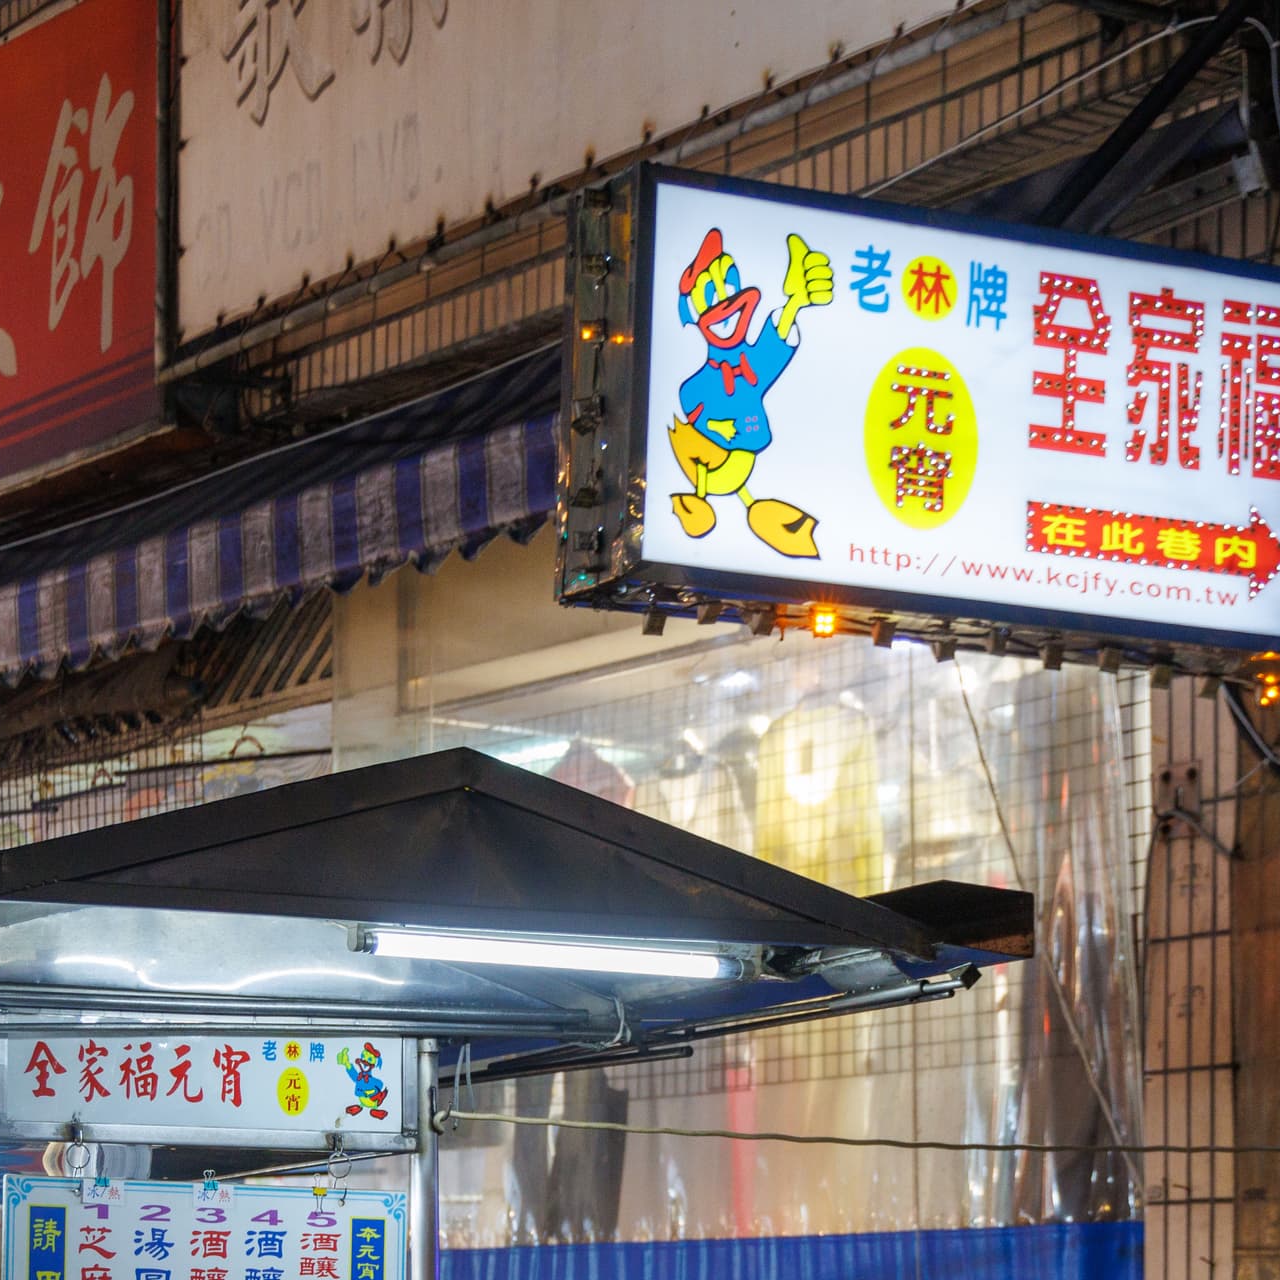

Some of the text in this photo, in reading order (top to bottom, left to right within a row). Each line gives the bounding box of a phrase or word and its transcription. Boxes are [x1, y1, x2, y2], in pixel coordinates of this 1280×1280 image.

[849, 246, 1008, 332] 老林牌
[890, 364, 956, 512] 元宵
[1040, 513, 1257, 570] 在此巷內
[849, 541, 1239, 608] http://www.kcjfy.com.tw
[262, 1040, 324, 1062] 老林牌
[25, 1040, 251, 1108] 全家福元宵
[285, 1073, 301, 1111] 元宵
[83, 1203, 109, 1219] 1
[139, 1204, 171, 1222] 2
[195, 1207, 227, 1223] 3
[250, 1209, 283, 1226] 4
[306, 1212, 337, 1227] 5
